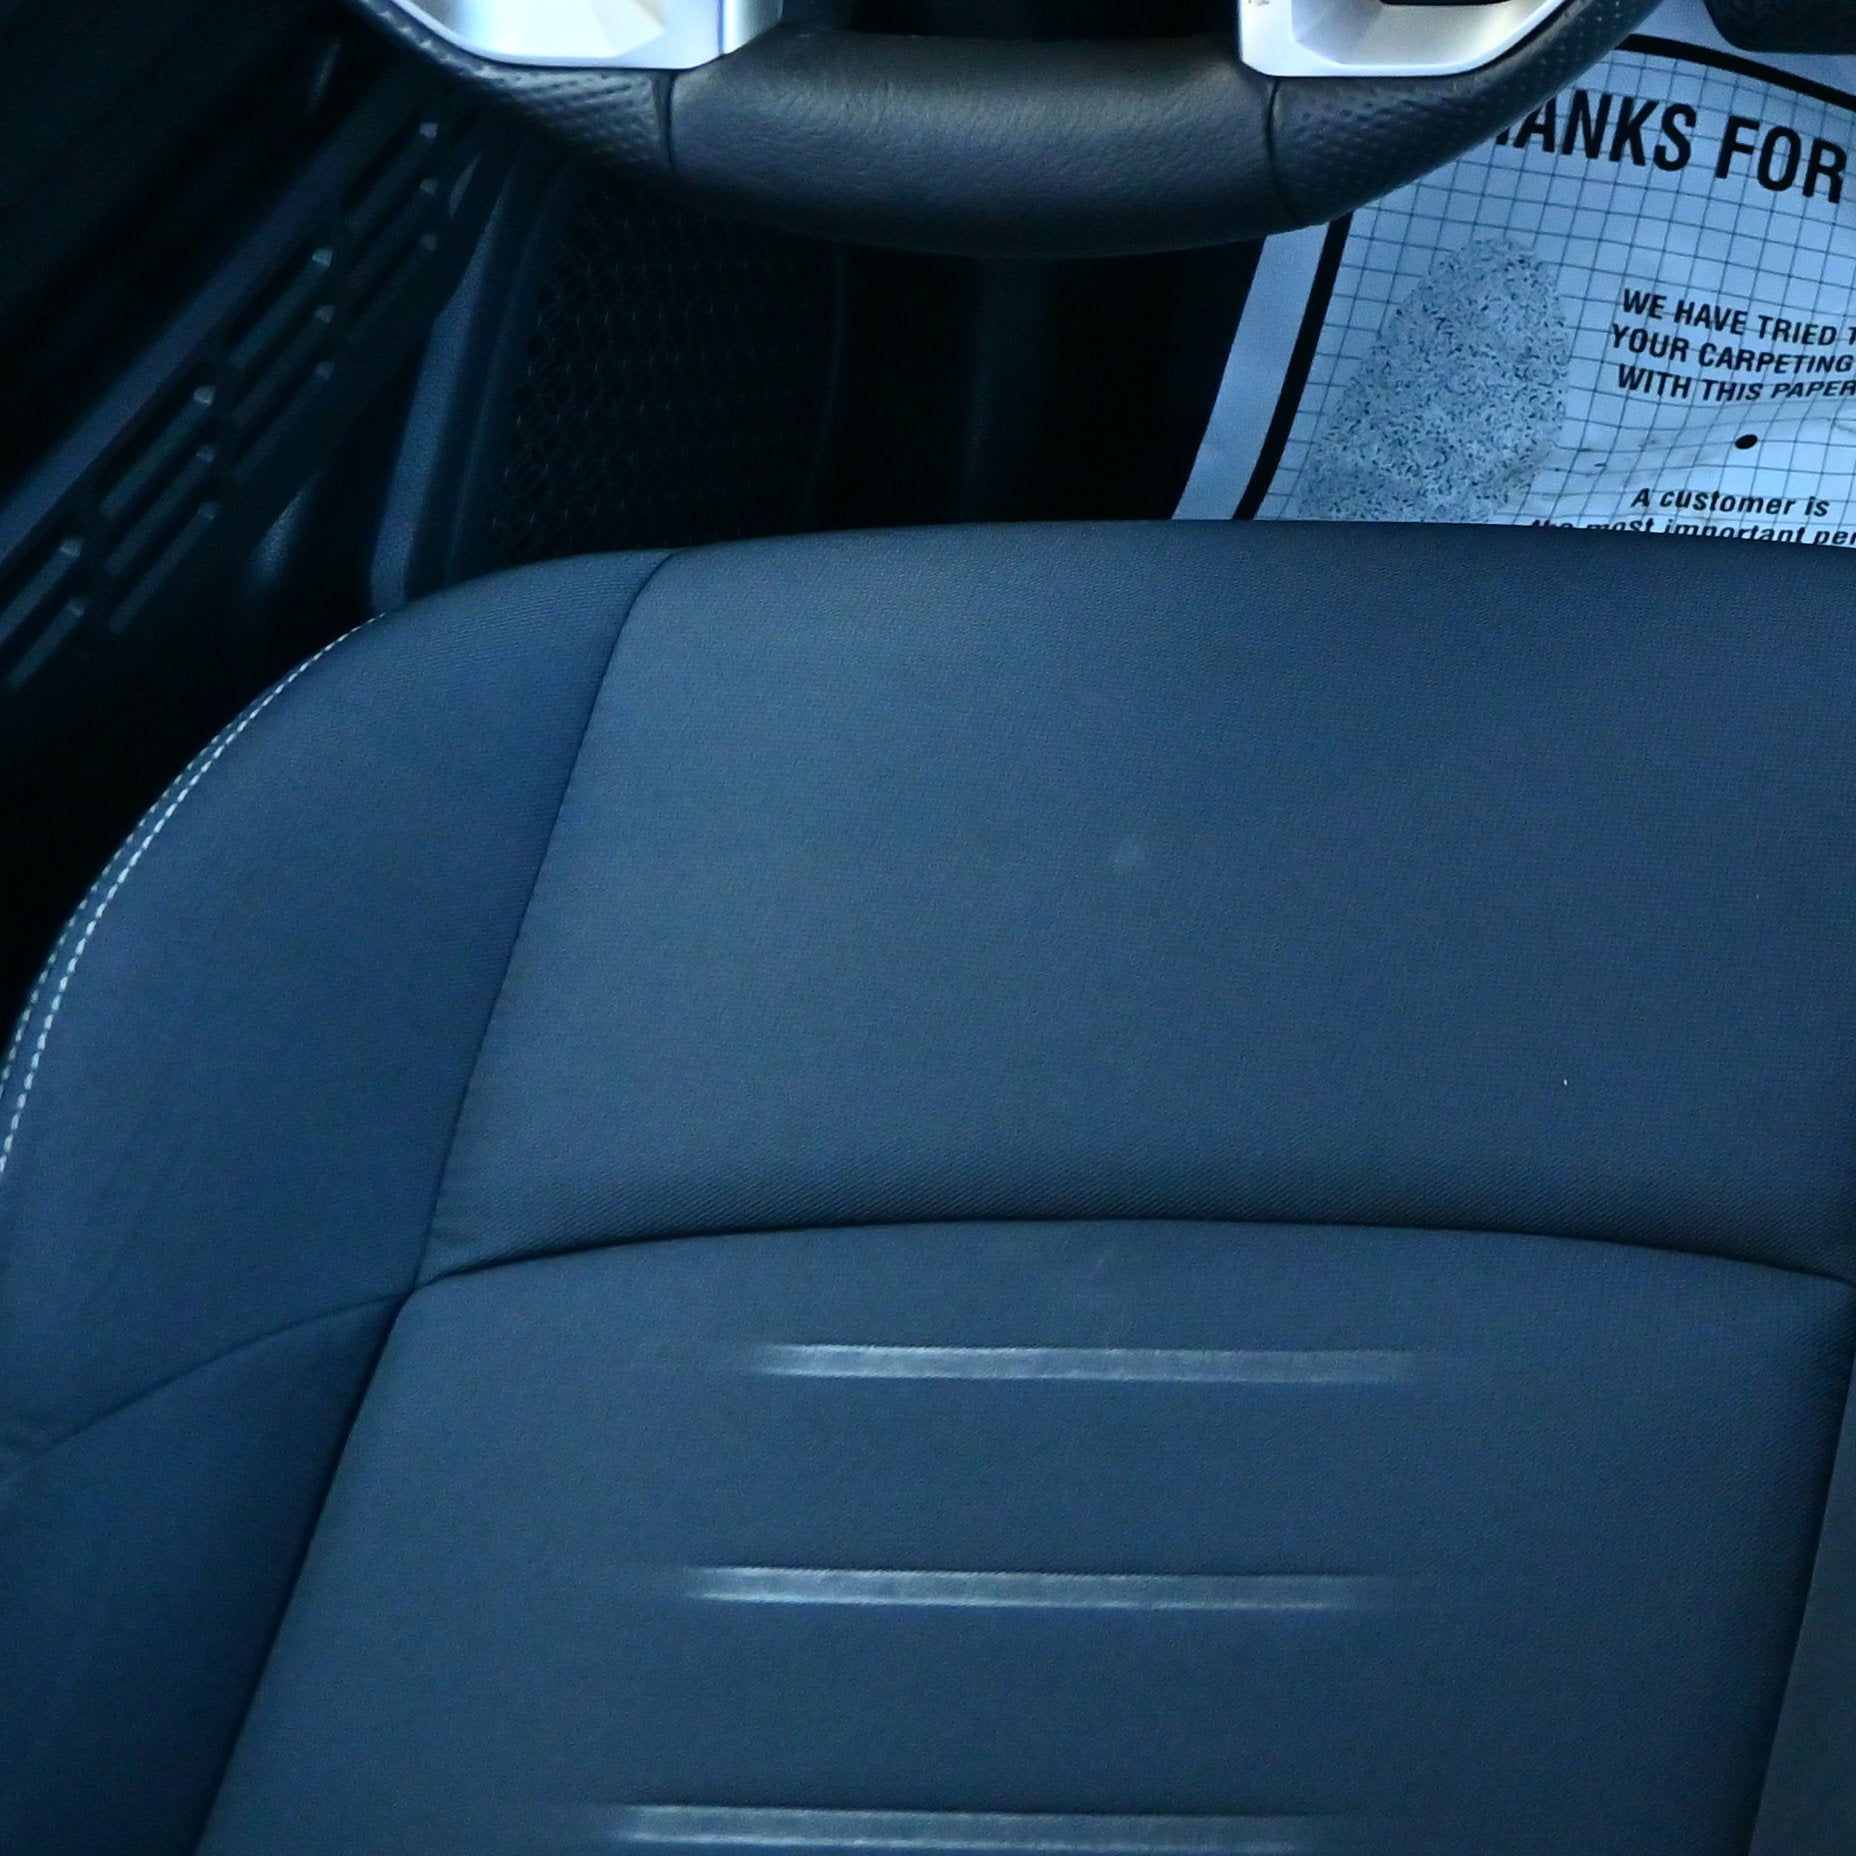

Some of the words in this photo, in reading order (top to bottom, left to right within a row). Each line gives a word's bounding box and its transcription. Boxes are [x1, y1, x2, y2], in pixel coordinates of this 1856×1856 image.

[1496, 89, 1697, 172] ANKS
[1716, 113, 1848, 204] FOR
[1623, 288, 1668, 319] WE
[1674, 299, 1748, 336] HAVE
[1758, 314, 1837, 346] TRIED
[1611, 324, 1689, 363] YOUR
[1699, 342, 1854, 375] CARPETING
[1617, 363, 1691, 400] WITH
[1702, 378, 1763, 402] THIS
[1631, 487, 1650, 508] A
[1660, 490, 1795, 516] customer
[1805, 495, 1830, 517] is
